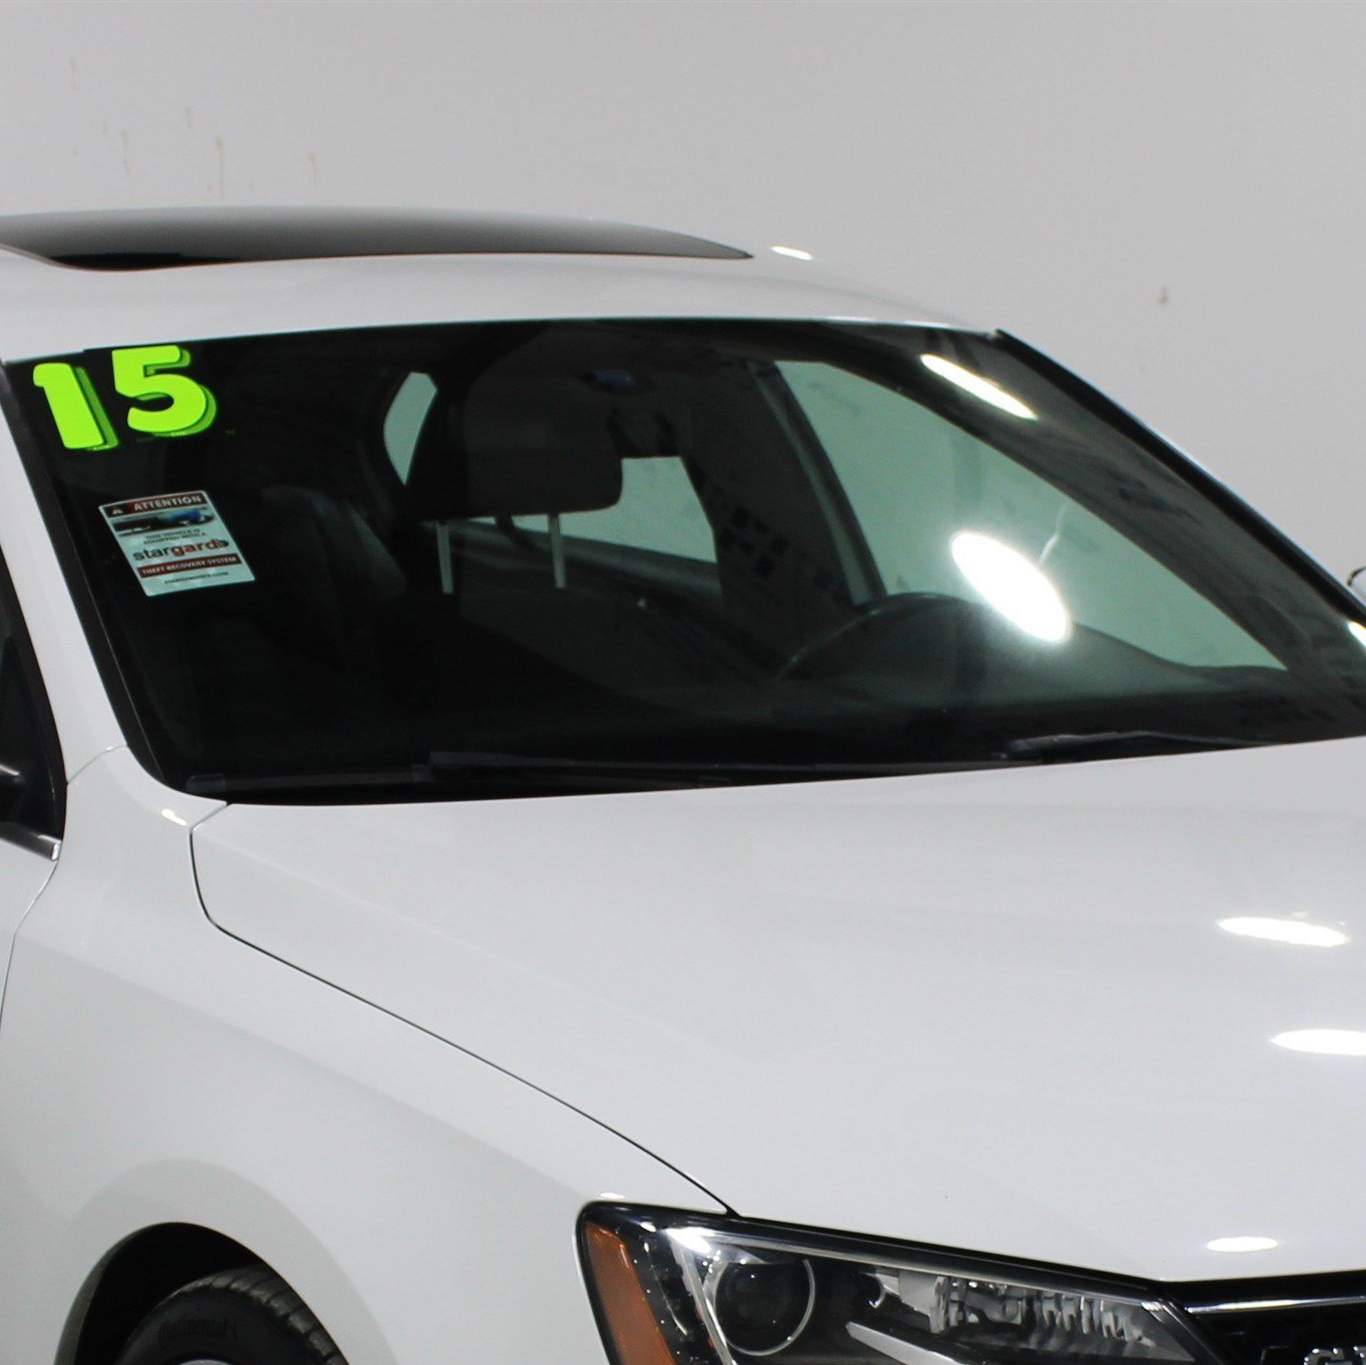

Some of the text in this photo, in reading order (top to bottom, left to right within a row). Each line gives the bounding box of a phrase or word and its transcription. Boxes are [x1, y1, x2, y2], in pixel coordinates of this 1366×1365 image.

[33, 345, 218, 451] 15
[134, 495, 202, 511] ATTENTION
[142, 556, 237, 576] THEFT RECOVERY SYSTEM
